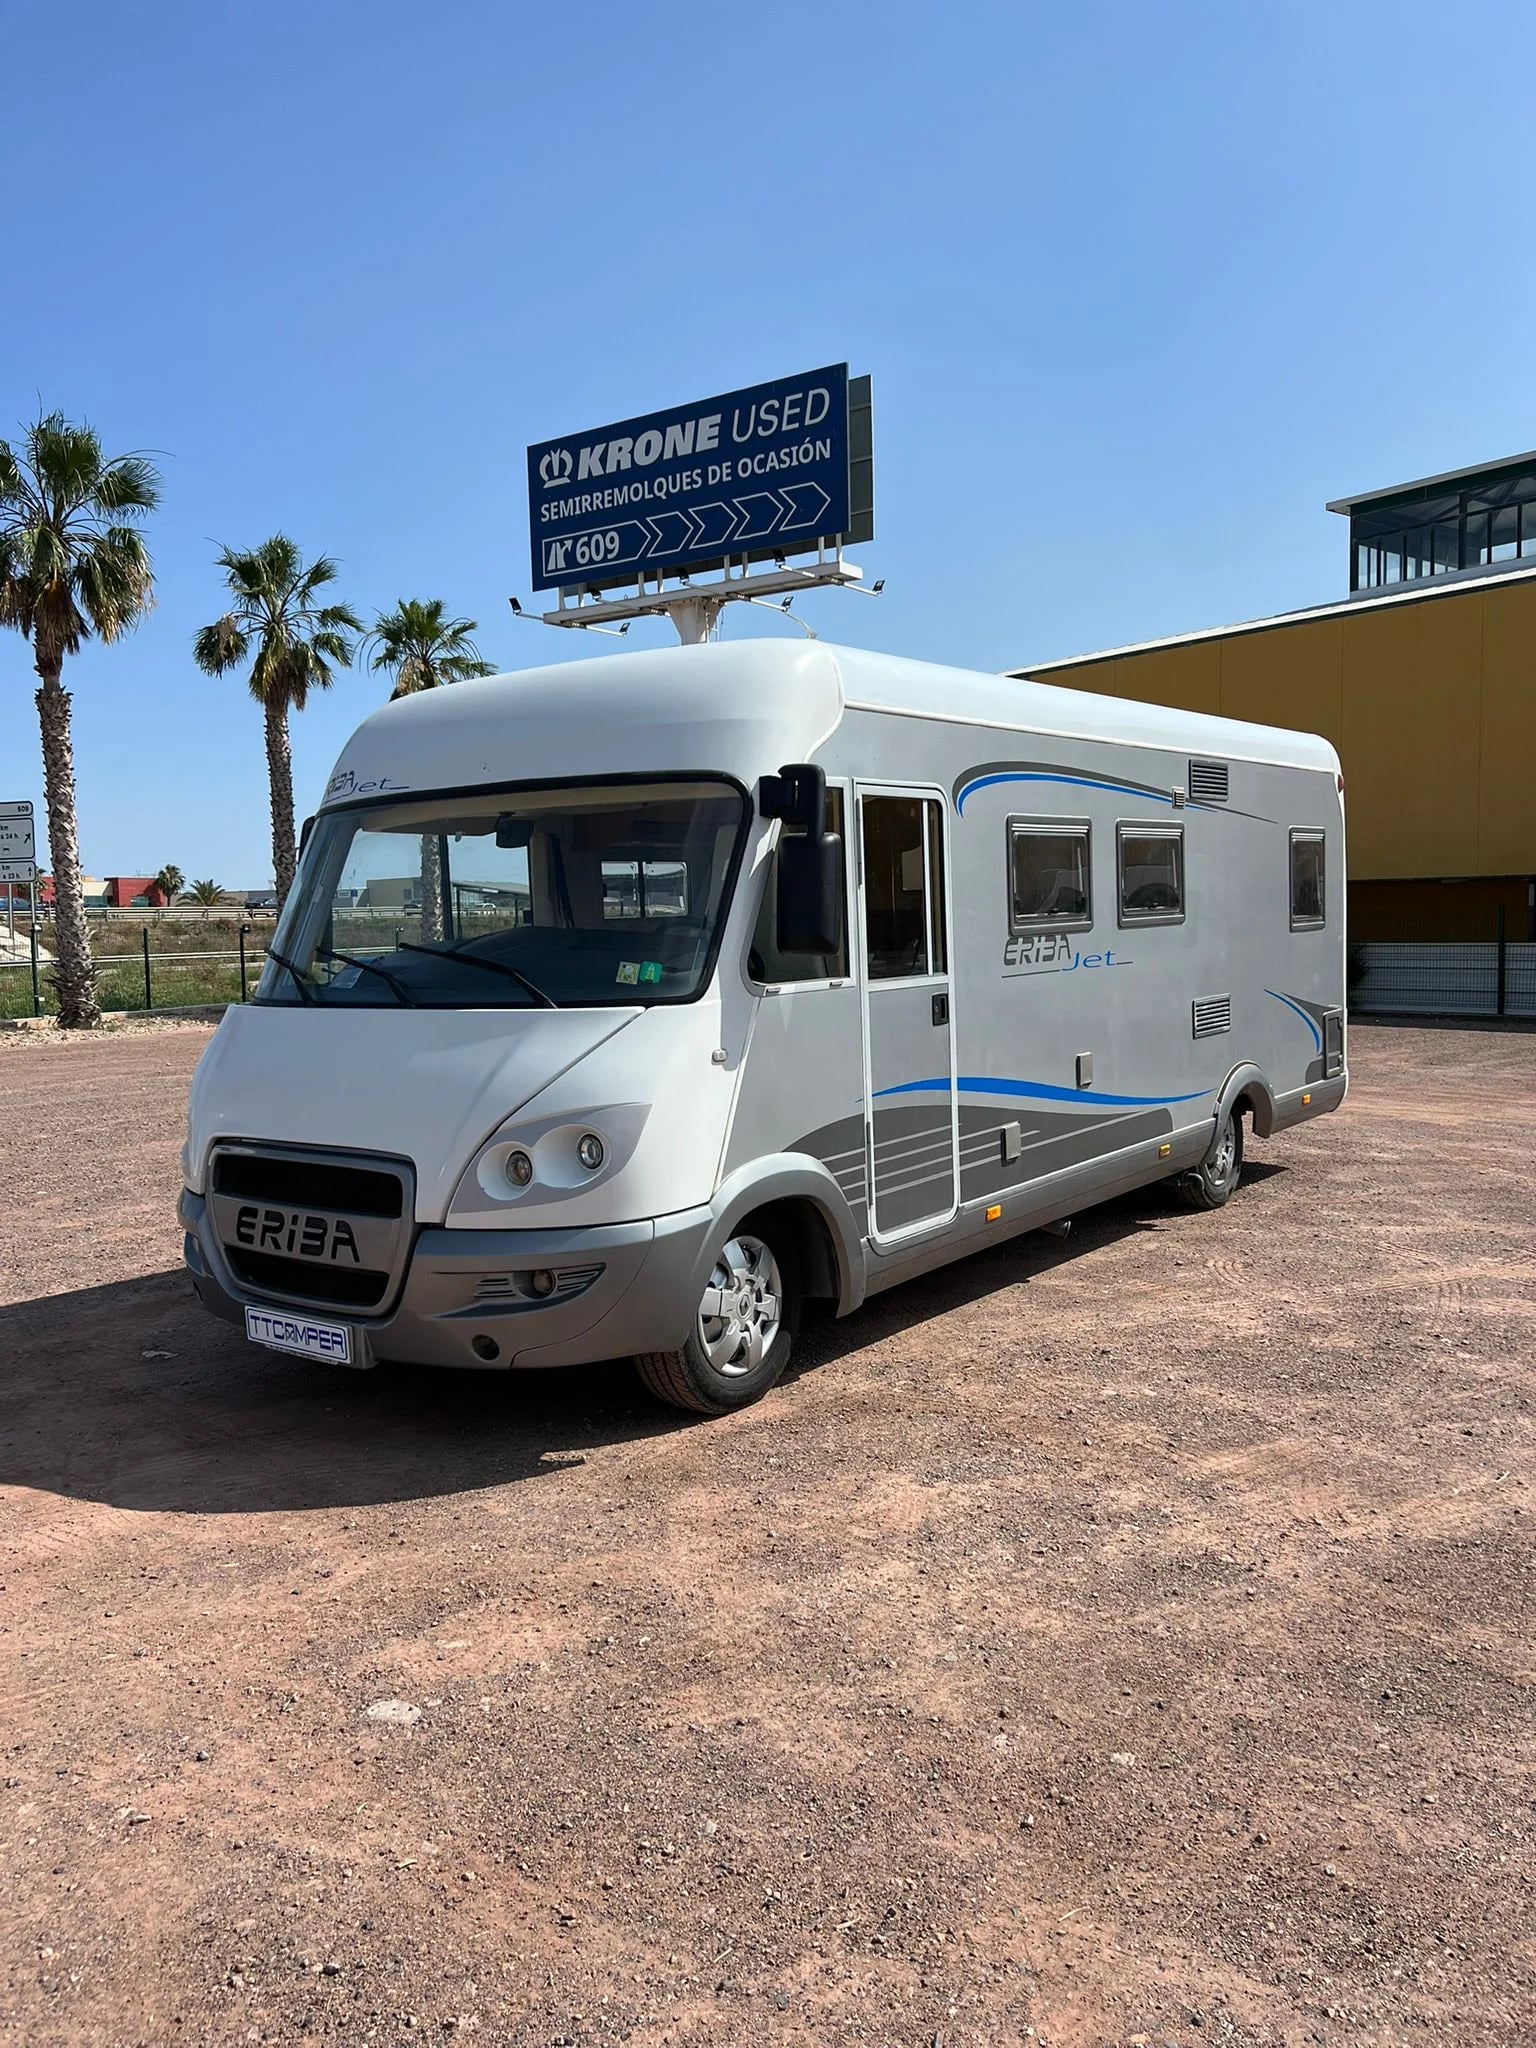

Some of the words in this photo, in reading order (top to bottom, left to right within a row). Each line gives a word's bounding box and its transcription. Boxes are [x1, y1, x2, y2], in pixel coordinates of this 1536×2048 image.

[577, 414, 722, 480] KRONE
[732, 387, 830, 443] USED
[540, 469, 702, 522] SEMIRREMOLQUES
[708, 462, 732, 486] DE
[737, 437, 831, 478] OCASIÓN
[576, 531, 620, 562] 609
[1003, 933, 1072, 966] ERIBA
[236, 1205, 361, 1263] ERIBA
